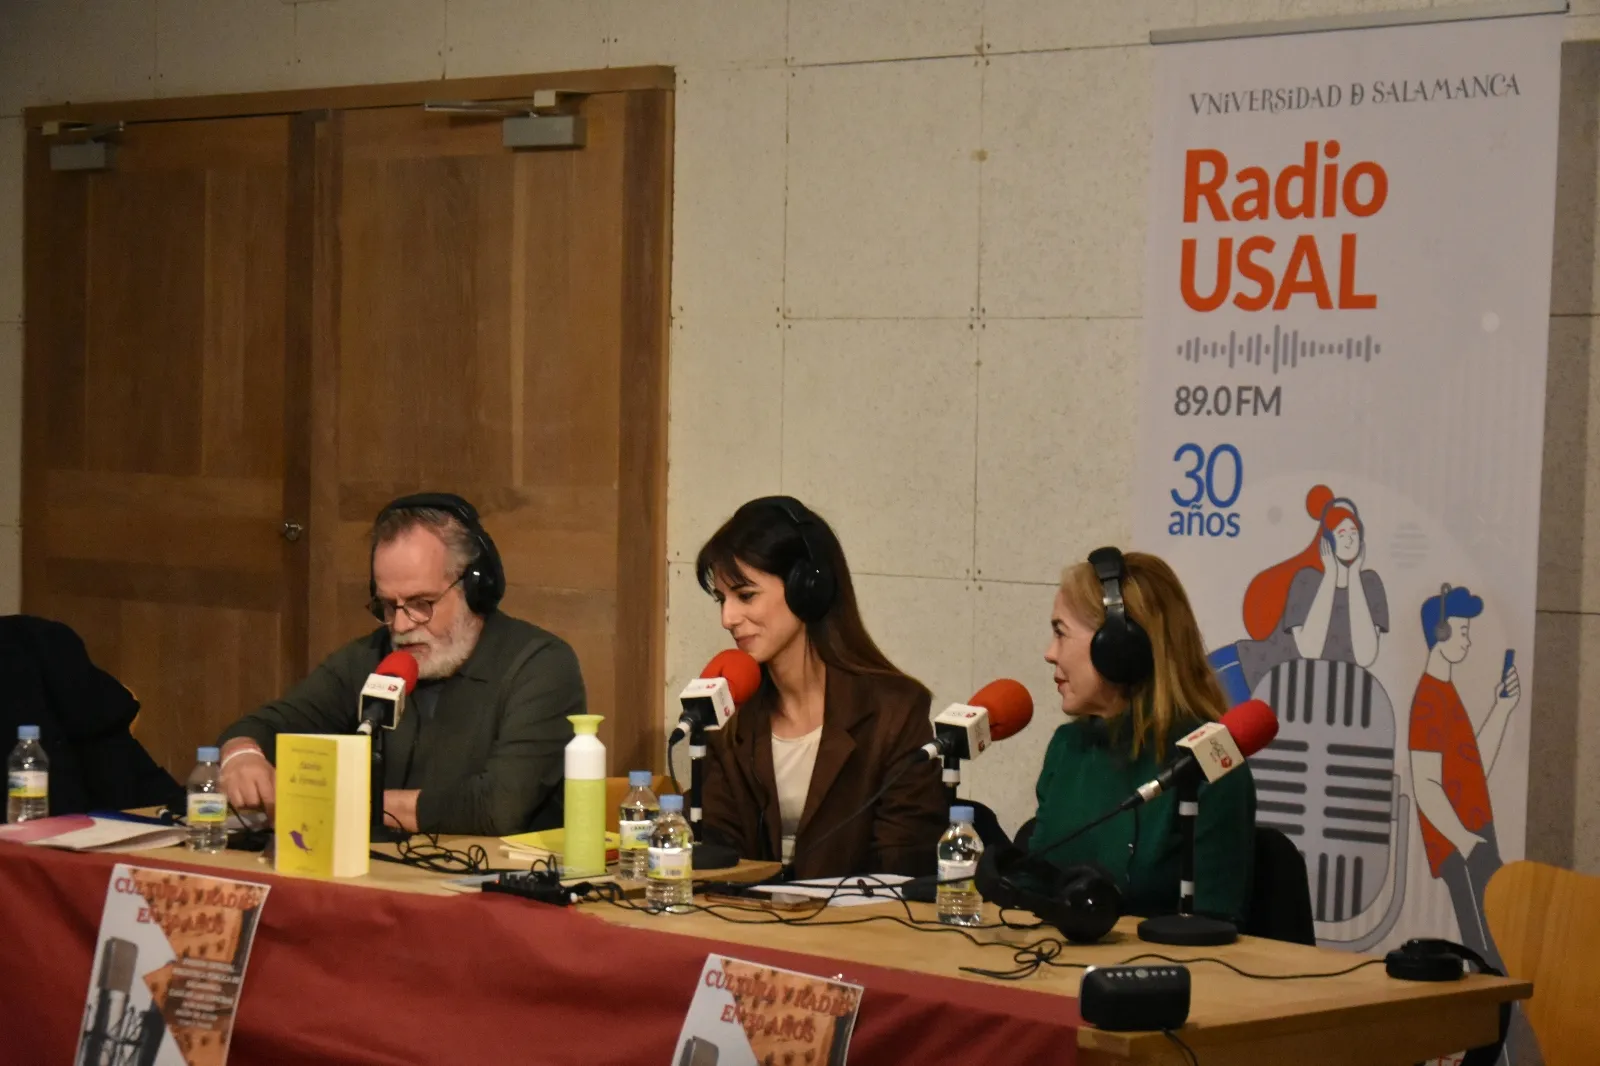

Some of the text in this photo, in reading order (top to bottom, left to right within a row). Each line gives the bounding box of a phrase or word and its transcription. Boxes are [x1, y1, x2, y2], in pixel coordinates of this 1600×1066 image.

[1372, 73, 1521, 104] SALAMANCA
[1183, 139, 1389, 224] Radio
[1180, 233, 1378, 313] USAL
[1170, 442, 1243, 509] 30
[1168, 504, 1241, 538] años
